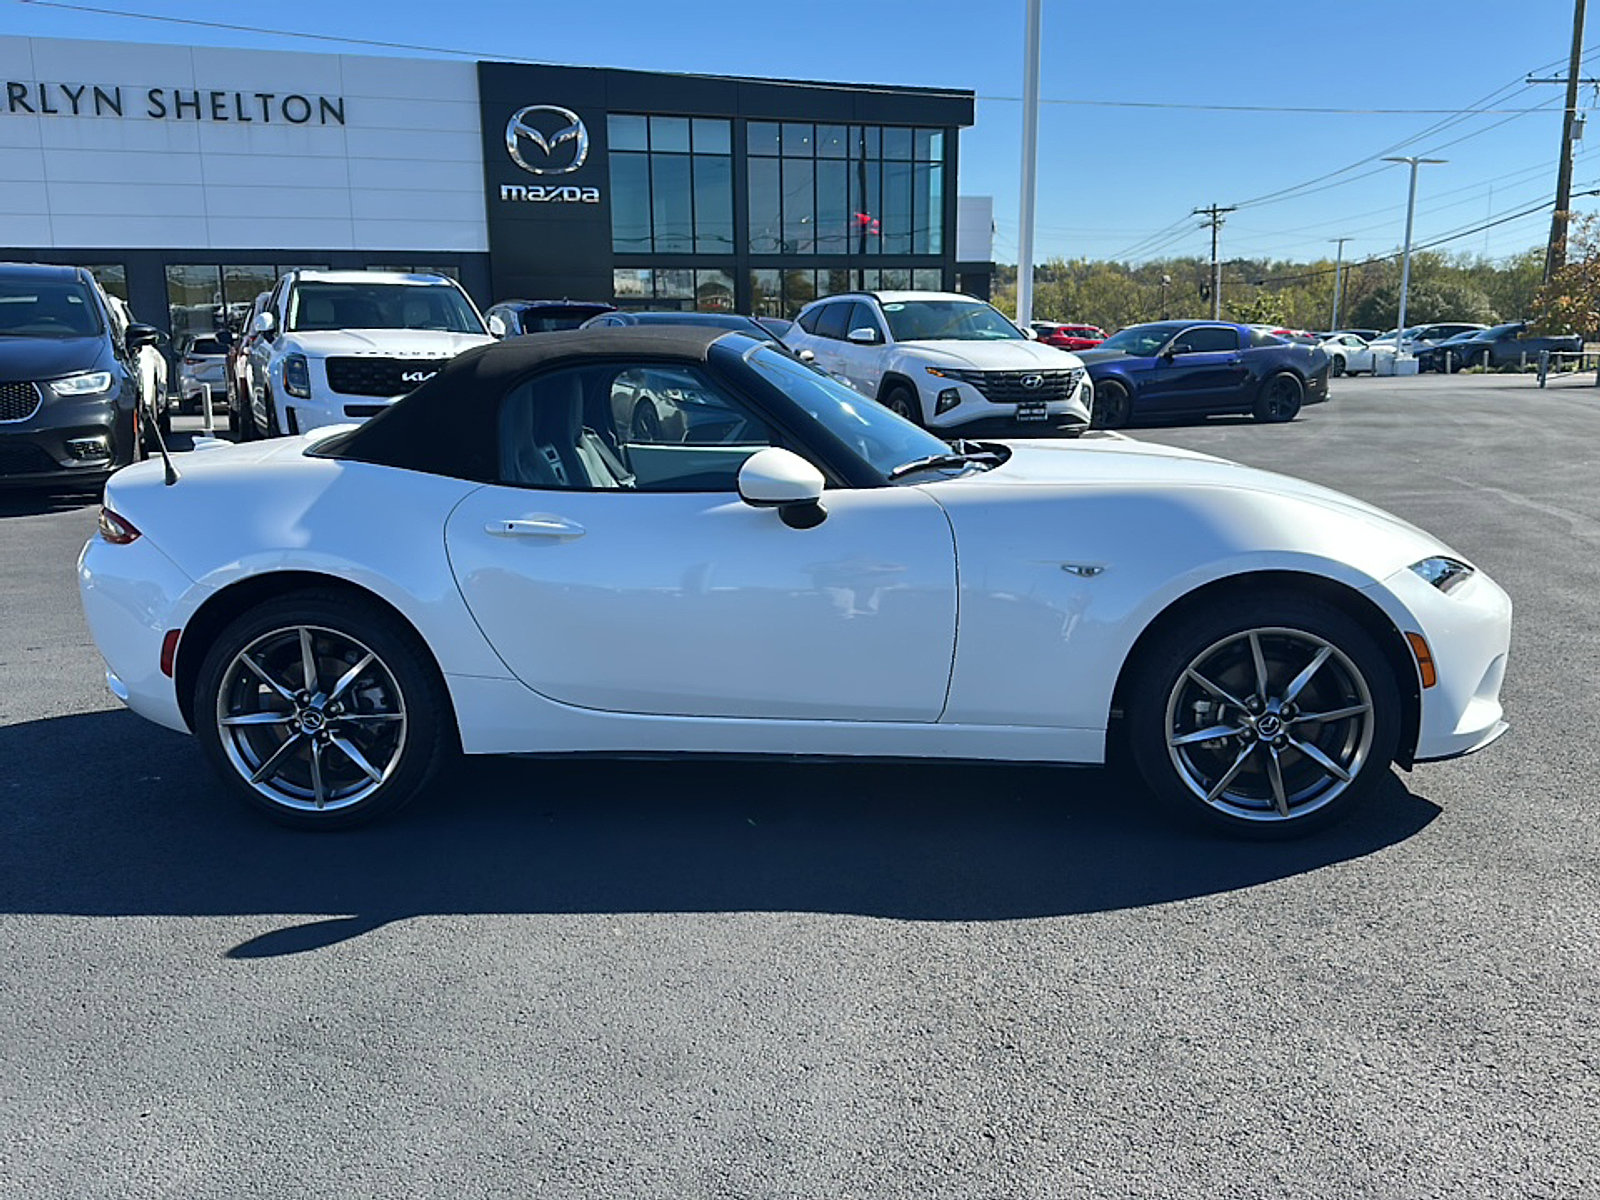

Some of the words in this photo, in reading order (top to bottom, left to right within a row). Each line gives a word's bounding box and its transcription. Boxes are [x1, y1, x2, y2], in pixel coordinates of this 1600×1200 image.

[0, 82, 122, 116] RLYN
[147, 88, 345, 125] SHELTON
[500, 184, 600, 203] mazda
